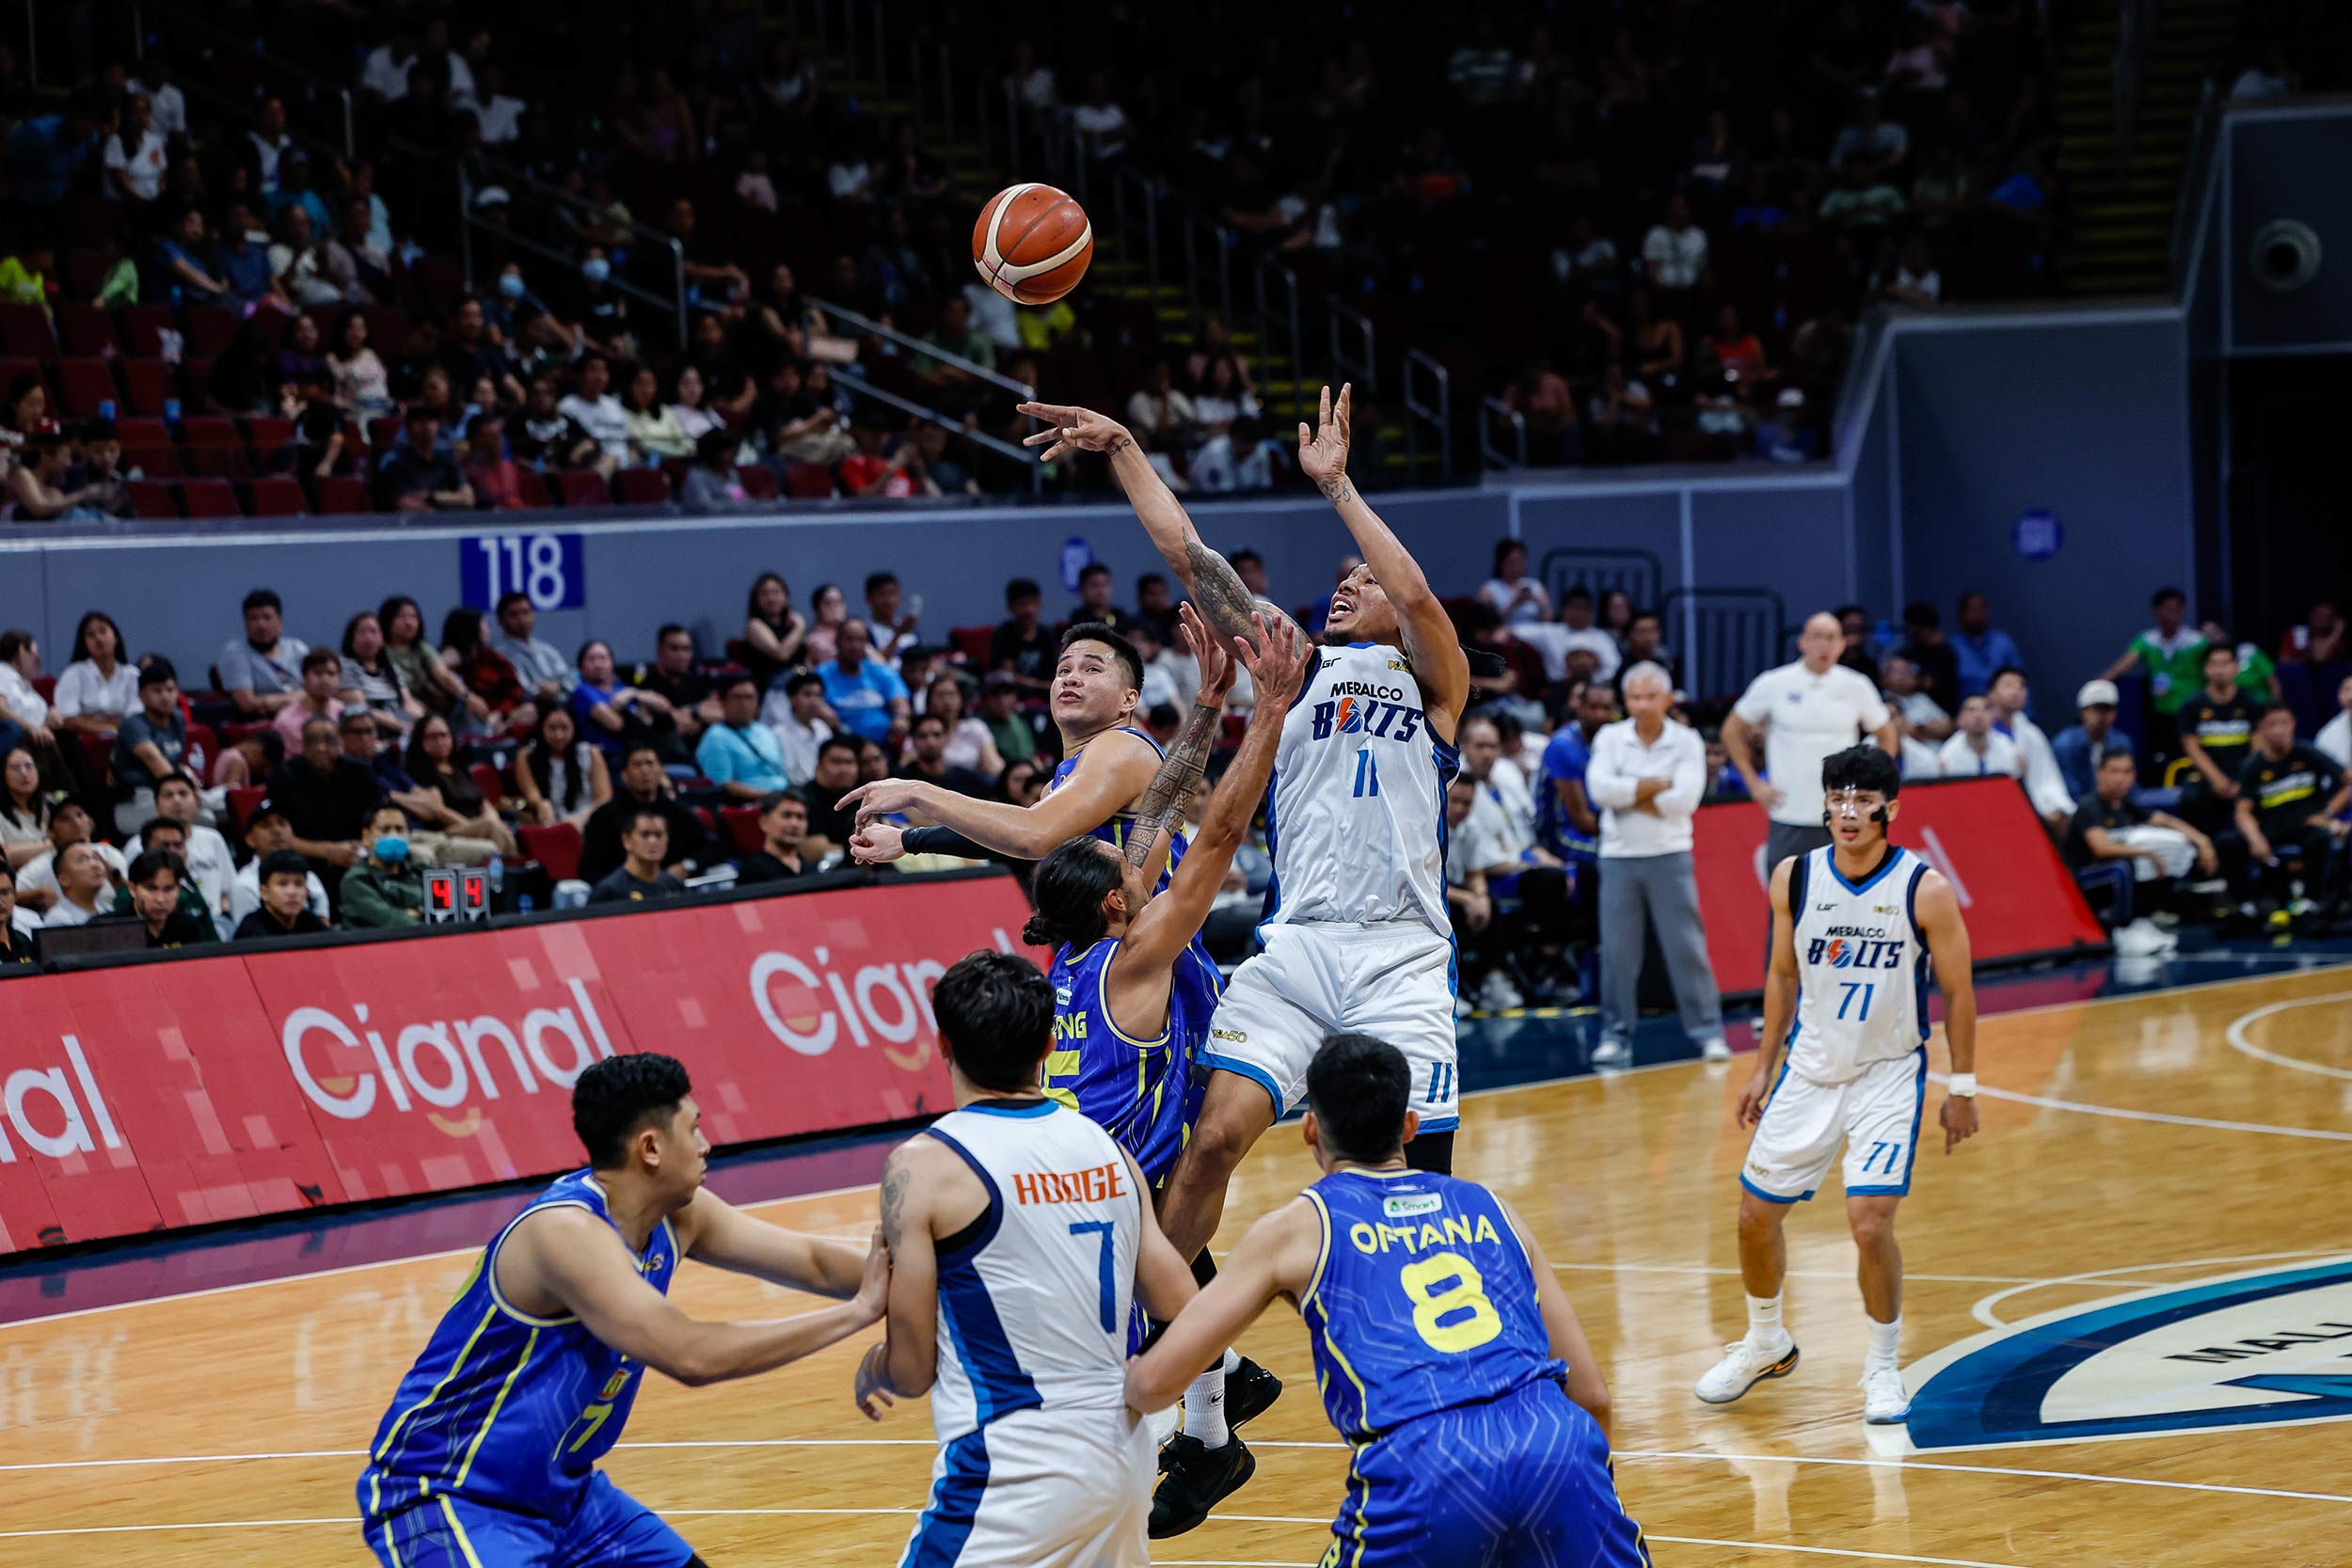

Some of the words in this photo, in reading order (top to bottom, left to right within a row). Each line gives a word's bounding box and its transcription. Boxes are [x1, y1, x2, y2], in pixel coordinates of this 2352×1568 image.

[479, 535, 566, 611] 118
[1330, 681, 1404, 702] MERALCO
[1311, 697, 1423, 743] BOLTS
[1353, 749, 1379, 798] 11
[432, 879, 452, 909] 4
[465, 877, 482, 906] 4
[1825, 926, 1886, 939] MERALCO
[1807, 939, 1905, 969] BOLTS
[1837, 982, 1875, 1022] 71
[1052, 1011, 1088, 1040] NG
[283, 977, 616, 1136] Cignal
[1425, 1061, 1453, 1103] 11
[1863, 1141, 1901, 1174] 71
[1012, 1162, 1127, 1206] HODGE
[1402, 1199, 1437, 1212] Smart
[1350, 1214, 1502, 1256] OFTANA
[1069, 1220, 1118, 1335] 7
[1400, 1251, 1503, 1354] 8
